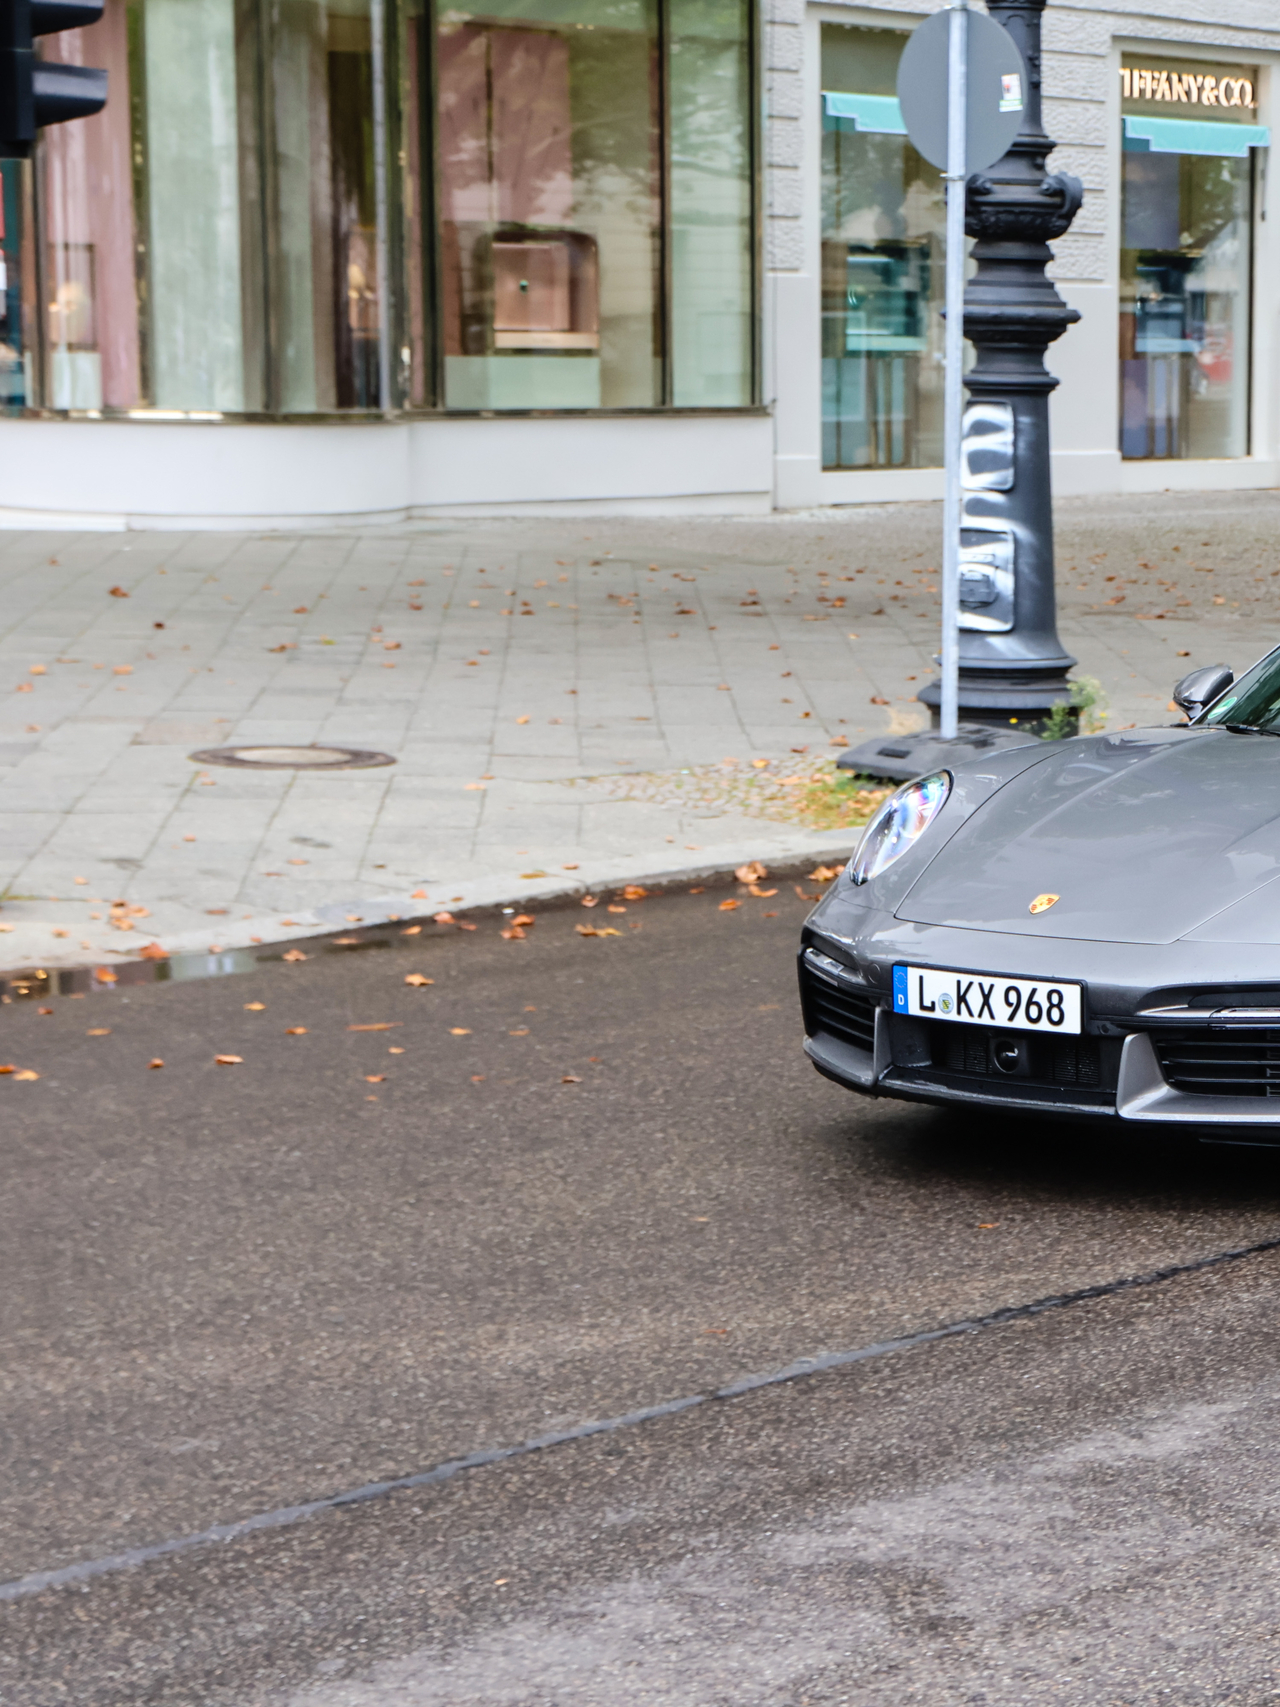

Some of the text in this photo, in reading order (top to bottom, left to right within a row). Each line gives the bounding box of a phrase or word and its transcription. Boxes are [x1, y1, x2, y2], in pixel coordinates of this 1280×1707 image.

[898, 994, 905, 1005] D
[919, 974, 1065, 1026] L KX 968
